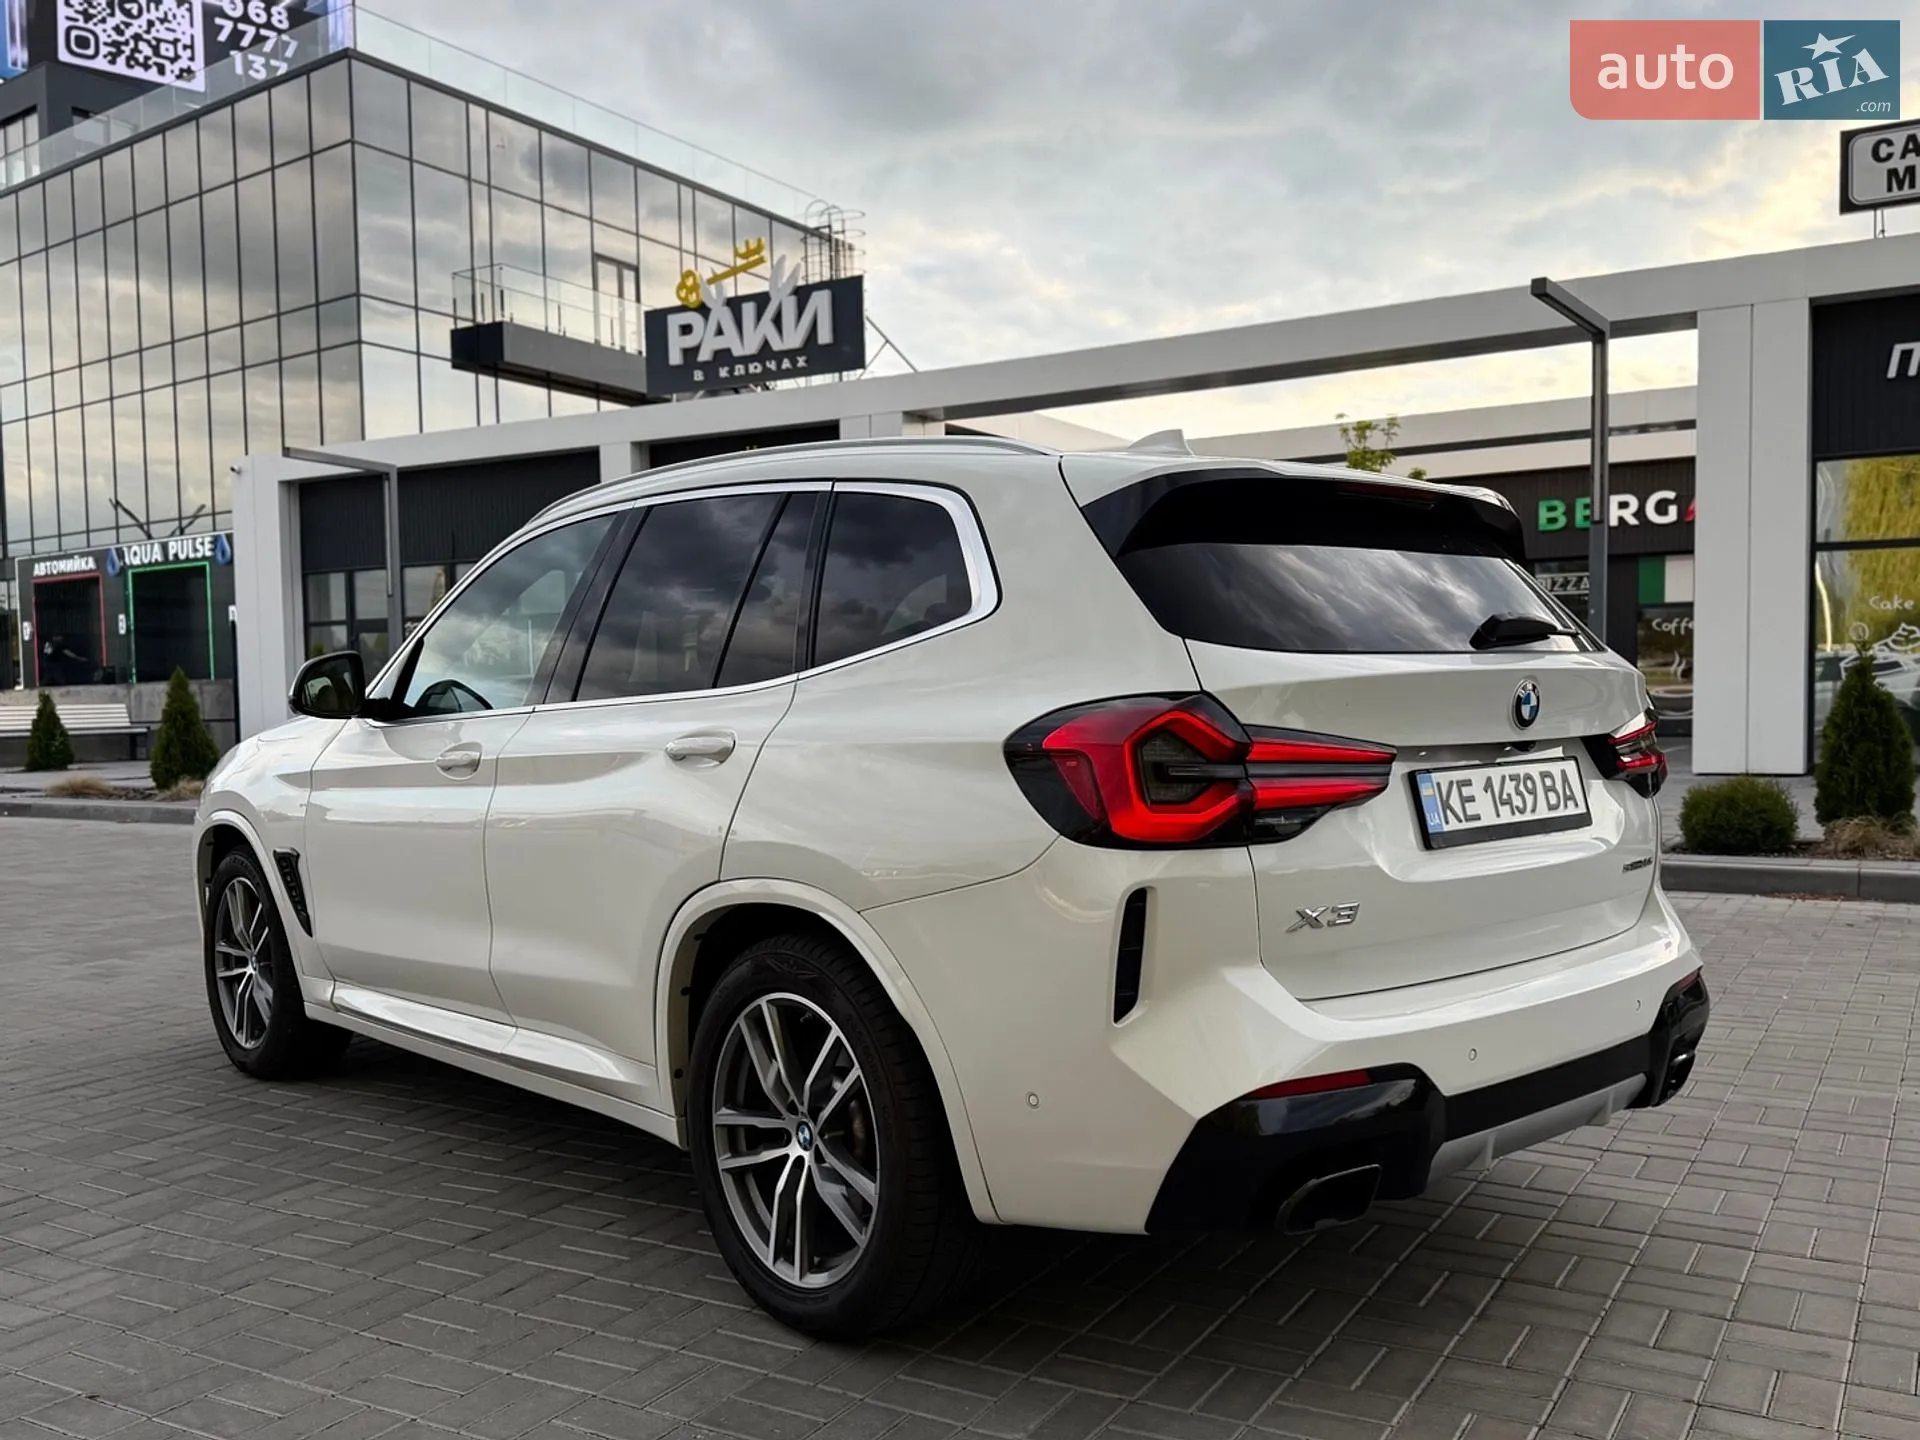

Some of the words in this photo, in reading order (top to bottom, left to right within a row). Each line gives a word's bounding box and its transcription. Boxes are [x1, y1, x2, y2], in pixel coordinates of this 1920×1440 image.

[214, 17, 298, 58] 7777
[229, 50, 288, 80] 137
[667, 284, 833, 366] РАКИ
[693, 369, 705, 382] В
[719, 355, 808, 378] КЛЮЧАХ
[168, 536, 215, 561] PULSE
[33, 555, 97, 577] АВТОМИЙКА
[1869, 594, 1915, 610] Cake
[1436, 778, 1482, 825] KE
[1482, 772, 1537, 819] 1439
[1541, 768, 1580, 813] BA
[1286, 901, 1361, 933] X3
